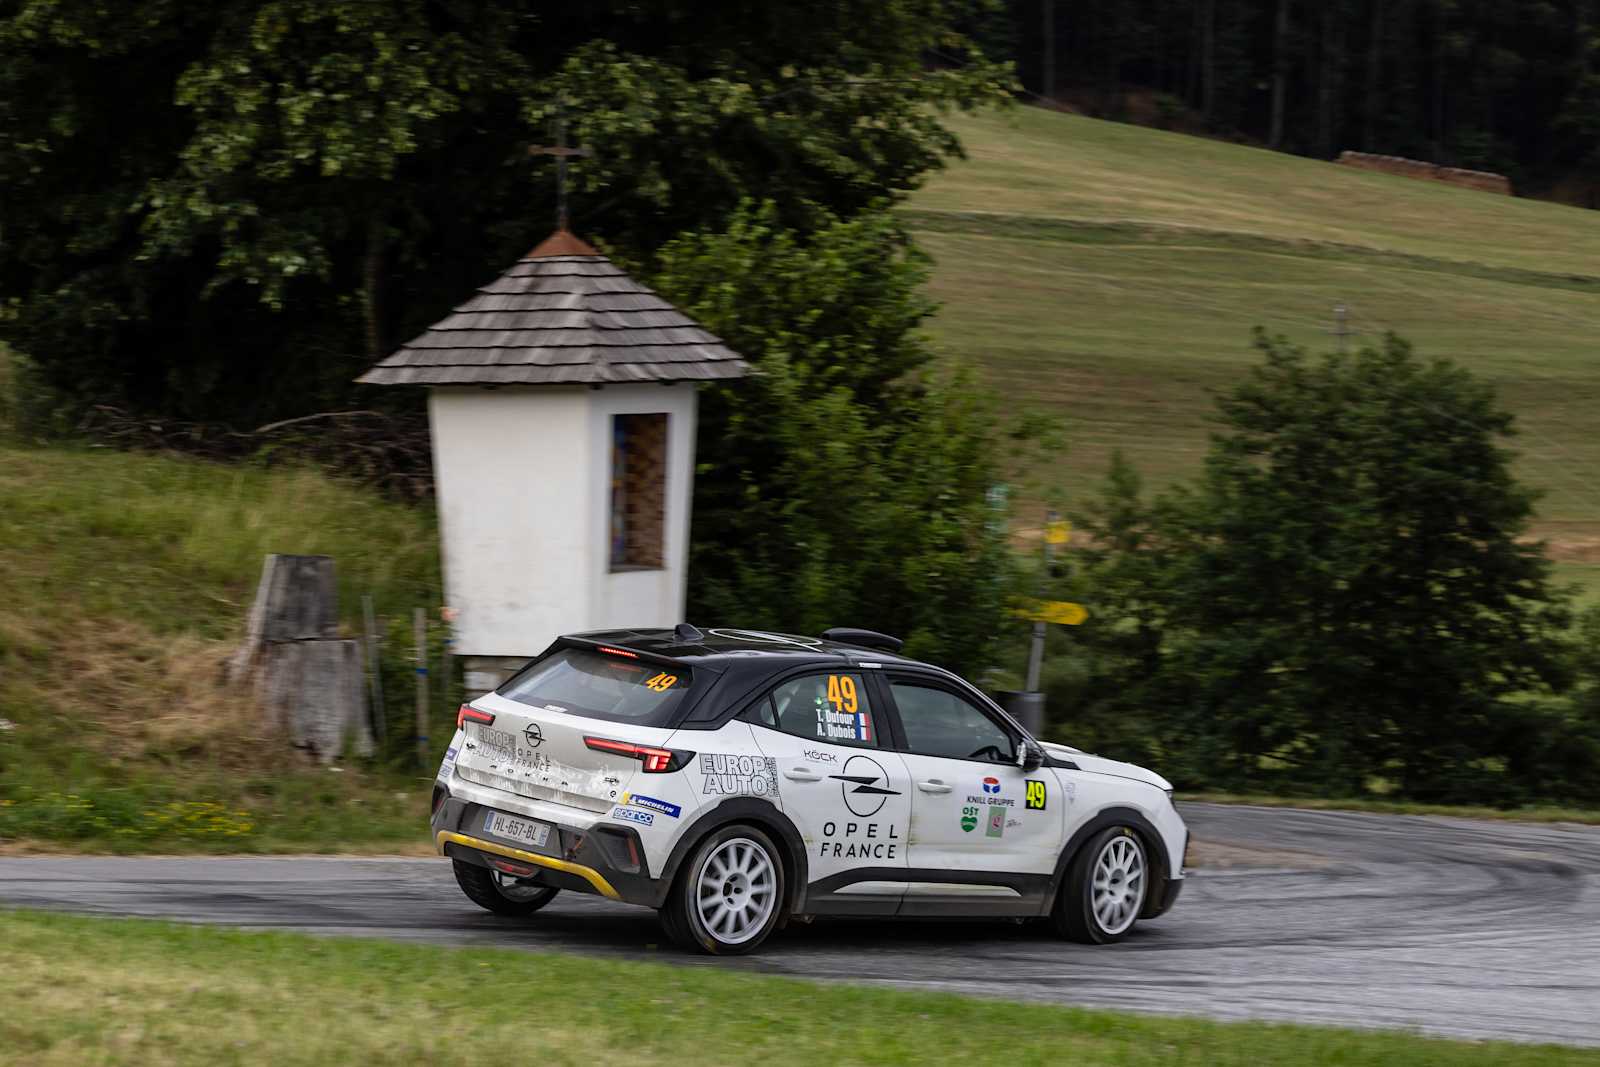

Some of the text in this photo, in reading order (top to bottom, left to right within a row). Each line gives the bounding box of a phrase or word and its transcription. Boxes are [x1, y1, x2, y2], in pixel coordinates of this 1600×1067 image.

[645, 672, 678, 692] 49
[827, 674, 858, 714] 49
[816, 709, 855, 725] T. Dufour
[816, 722, 856, 739] A. Dubois
[517, 748, 551, 763] OPEL
[516, 757, 551, 773] FRANCE
[699, 753, 766, 777] EUROP
[703, 773, 769, 796] AUTO
[967, 796, 1015, 806] KNILL GRUPPE
[1026, 781, 1046, 808] 49
[637, 798, 675, 814] MICHELIN
[614, 808, 652, 822] sparco
[494, 815, 537, 841] HL-657-BL
[823, 821, 898, 839] OPEL
[820, 842, 897, 859] FRANCE
